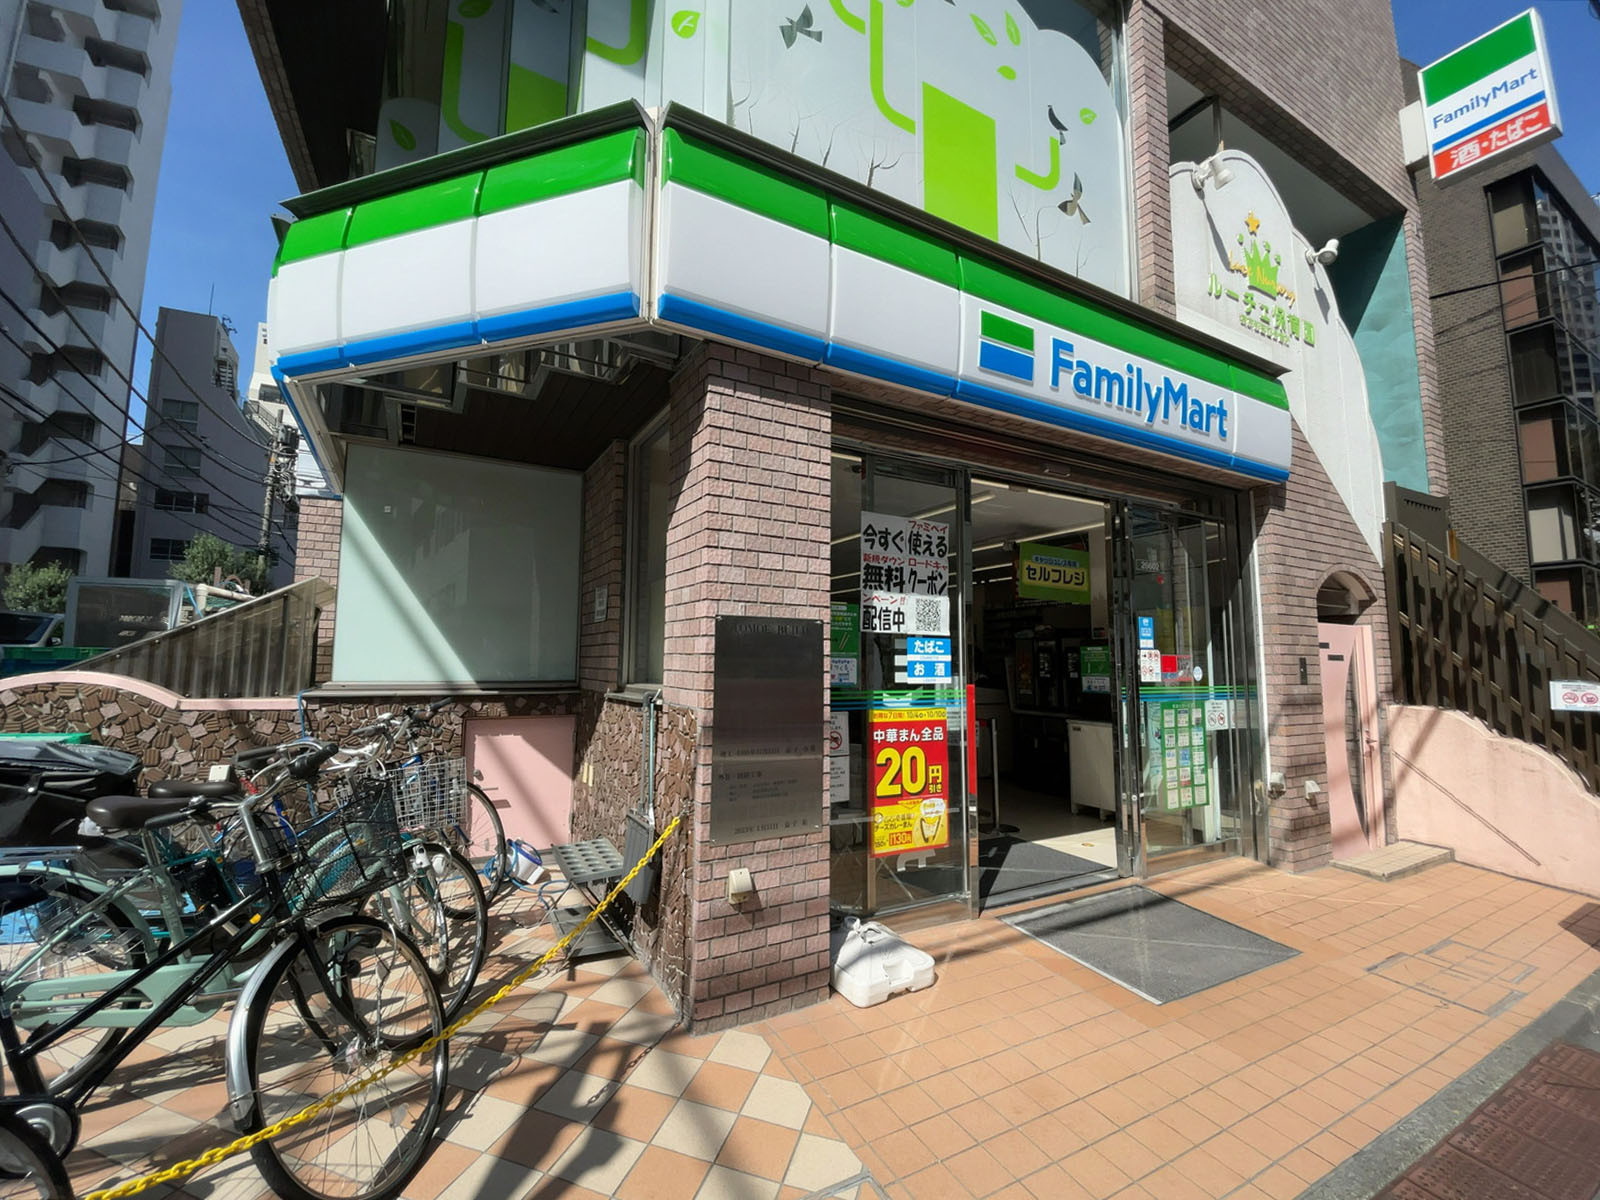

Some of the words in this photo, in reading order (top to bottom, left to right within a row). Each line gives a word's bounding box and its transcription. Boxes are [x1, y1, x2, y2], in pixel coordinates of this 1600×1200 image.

[1433, 67, 1538, 129] FamilyMart
[1450, 111, 1543, 169] 酒・たばこ
[1049, 336, 1228, 440] FamilyMart
[1026, 564, 1085, 586] セルフレジ
[862, 605, 905, 632] 配信中
[913, 639, 945, 654] たばこ
[873, 726, 944, 744] 中華まん全品
